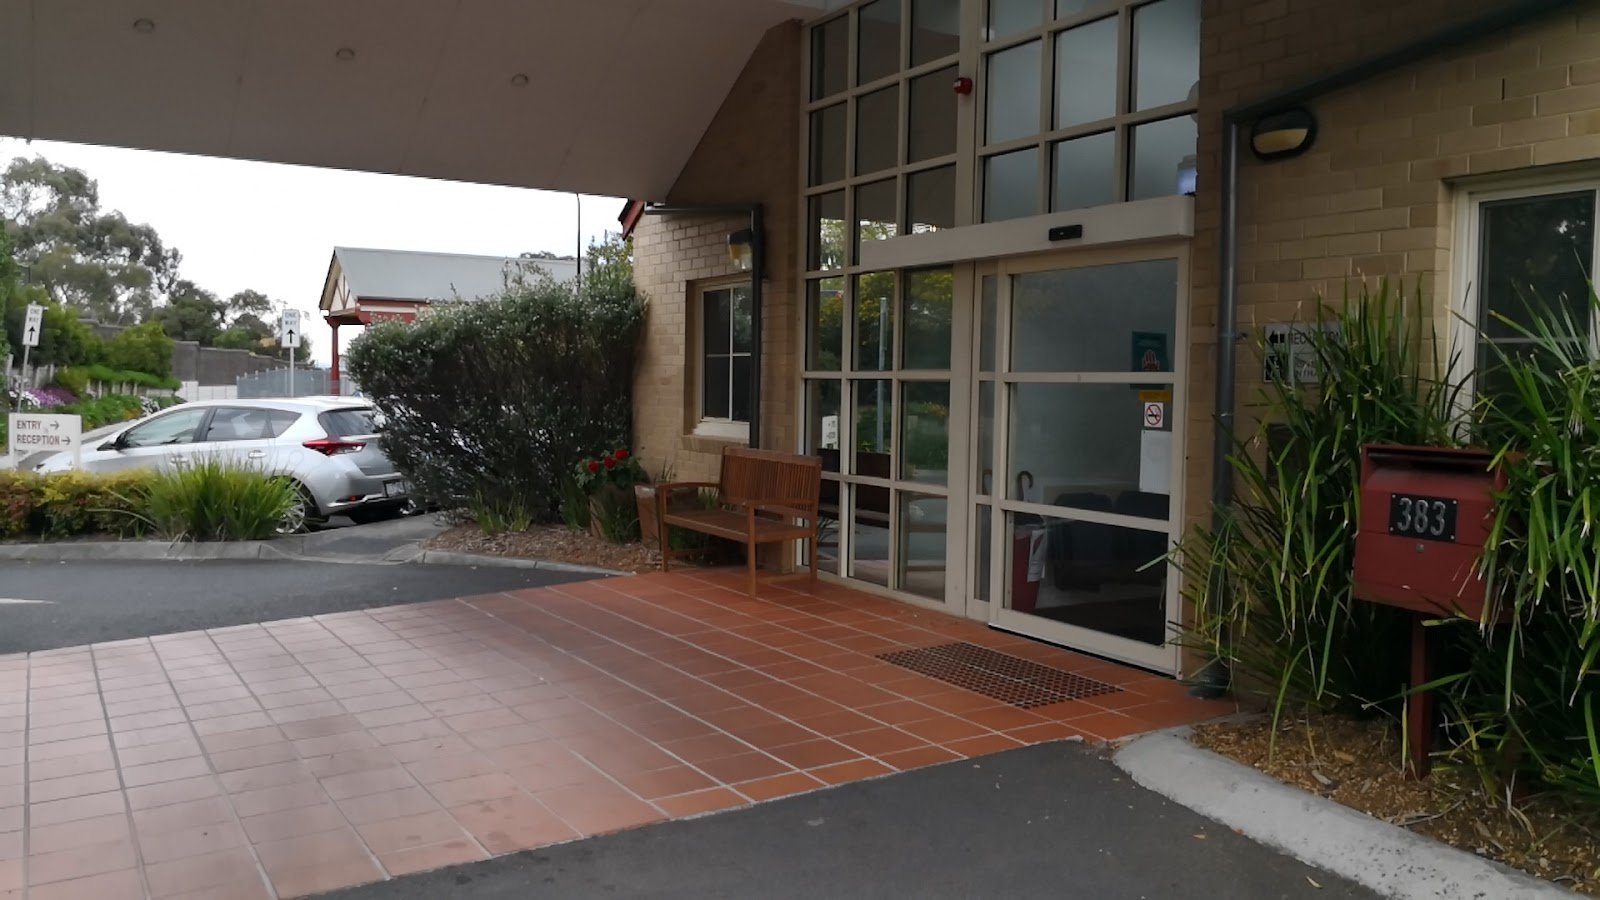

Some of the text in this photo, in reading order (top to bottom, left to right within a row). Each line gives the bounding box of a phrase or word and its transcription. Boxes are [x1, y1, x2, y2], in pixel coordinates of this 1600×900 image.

[17, 420, 42, 430] ENTRY
[17, 434, 60, 445] RECEPTION
[1397, 497, 1446, 536] 383
